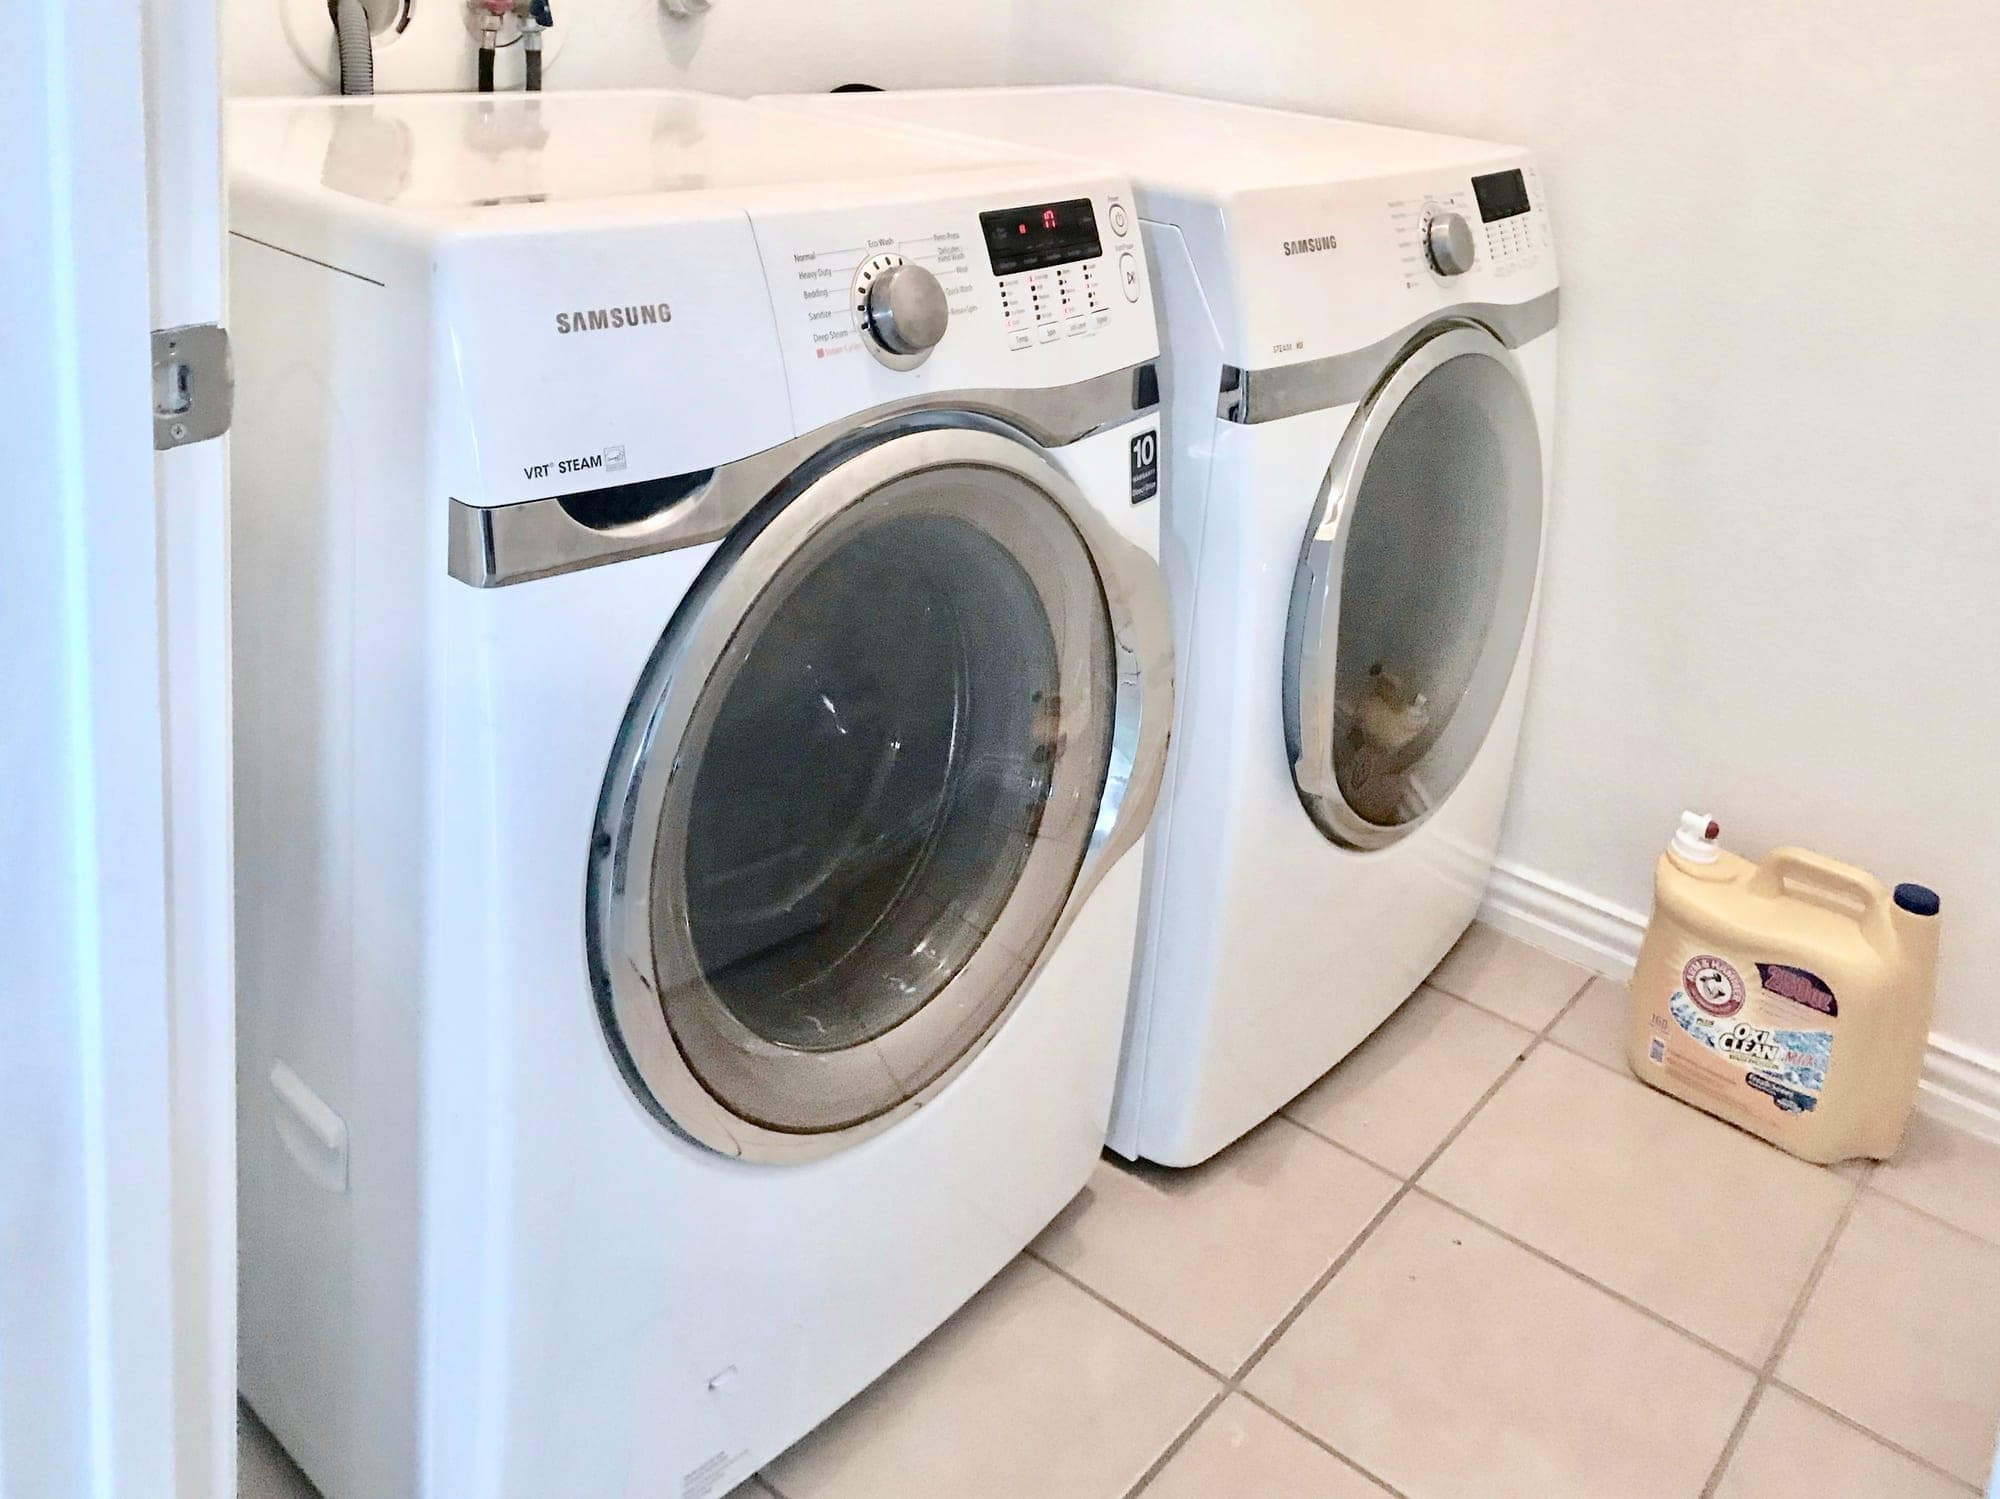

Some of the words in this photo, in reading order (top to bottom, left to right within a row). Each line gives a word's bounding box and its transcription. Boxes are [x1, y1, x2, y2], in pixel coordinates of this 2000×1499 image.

[867, 239, 878, 248] Eco
[1283, 235, 1337, 256] SAMSUNG
[793, 251, 816, 263] Normal
[798, 270, 817, 280] Heavy
[817, 268, 832, 278] Duty
[803, 288, 829, 300] Bedding
[556, 303, 672, 334] SAMSUNG
[808, 310, 832, 321] Sanitize
[813, 332, 829, 343] Deep
[1133, 435, 1155, 468] 10
[558, 455, 602, 474] STEAM
[1733, 1022, 1770, 1045] OXI
[1719, 1032, 1780, 1060] CLEAN
